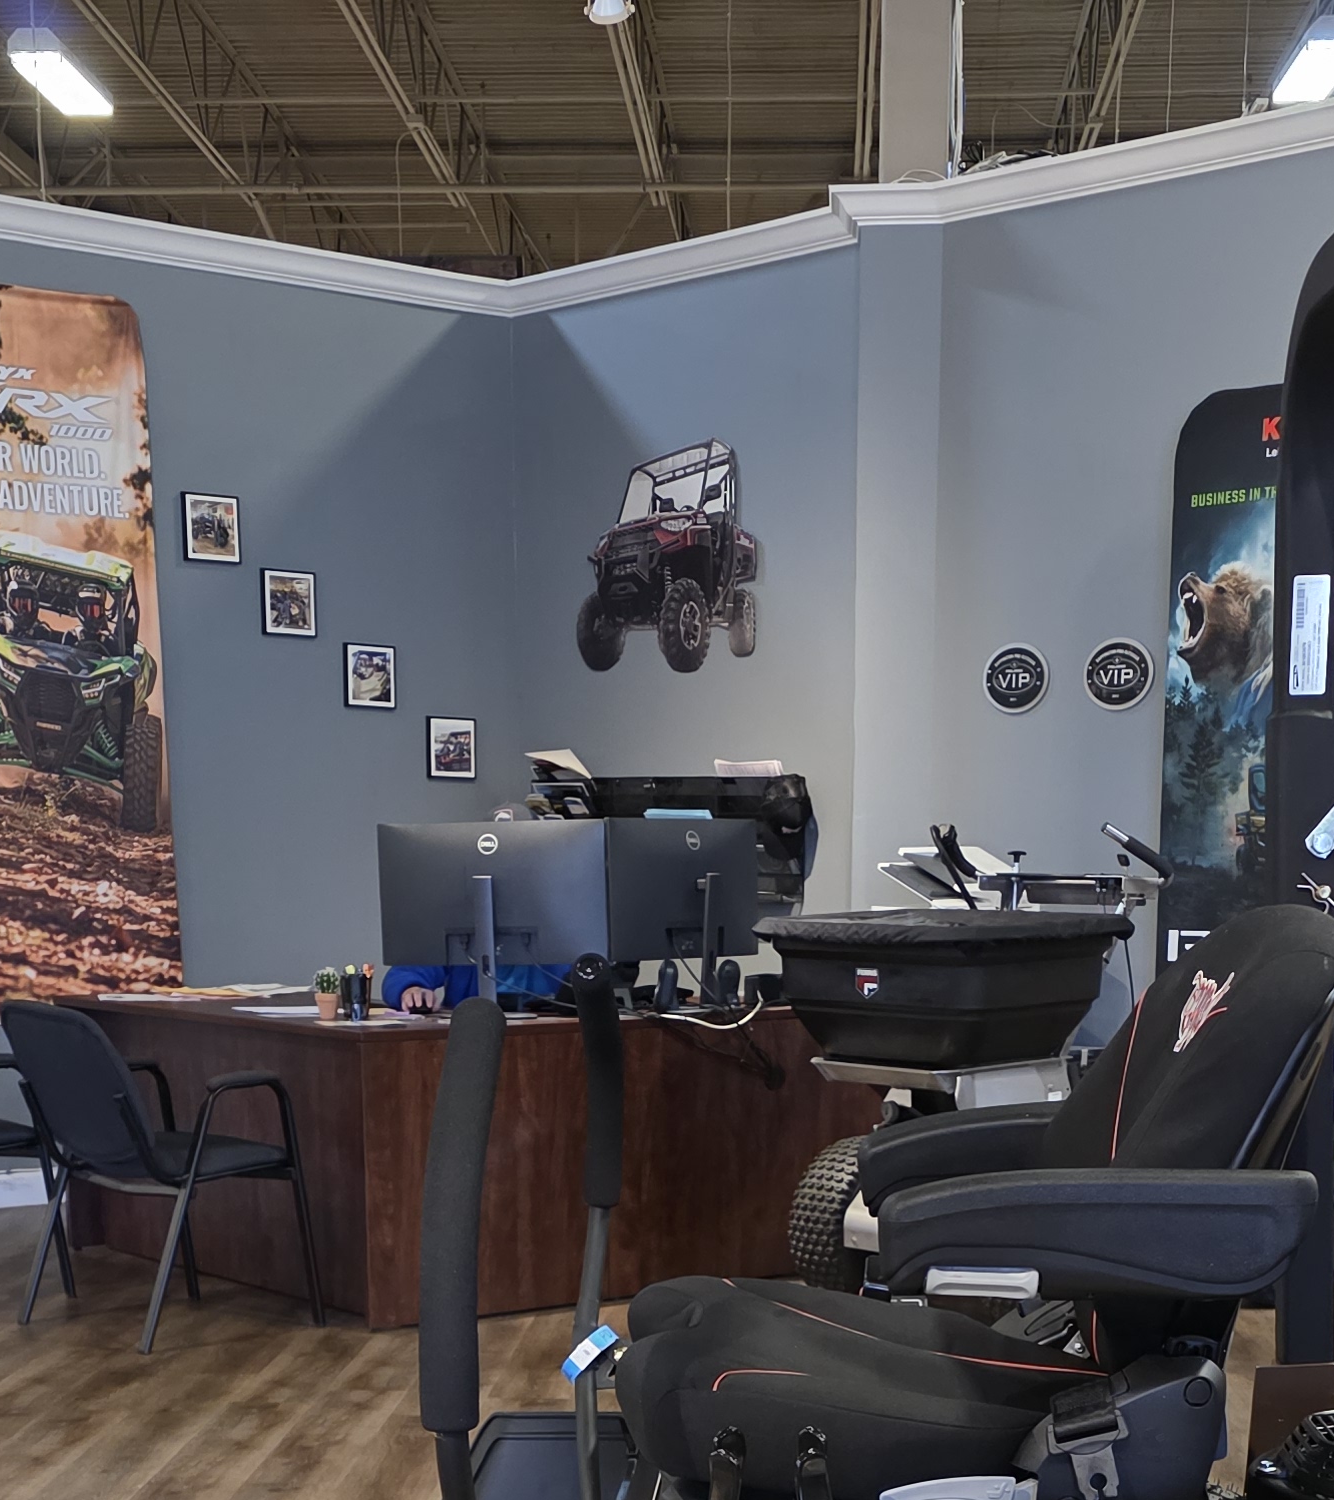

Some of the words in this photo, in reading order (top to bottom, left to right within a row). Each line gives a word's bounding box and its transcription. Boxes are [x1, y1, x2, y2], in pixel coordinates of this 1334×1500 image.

[49, 423, 113, 442] 1000
[19, 443, 107, 480] WORLD.
[1190, 488, 1246, 508] BUSINESS
[1249, 486, 1261, 500] IN
[1264, 485, 1277, 500] TH
[998, 672, 1030, 689] VIP
[1099, 668, 1134, 685] VIP
